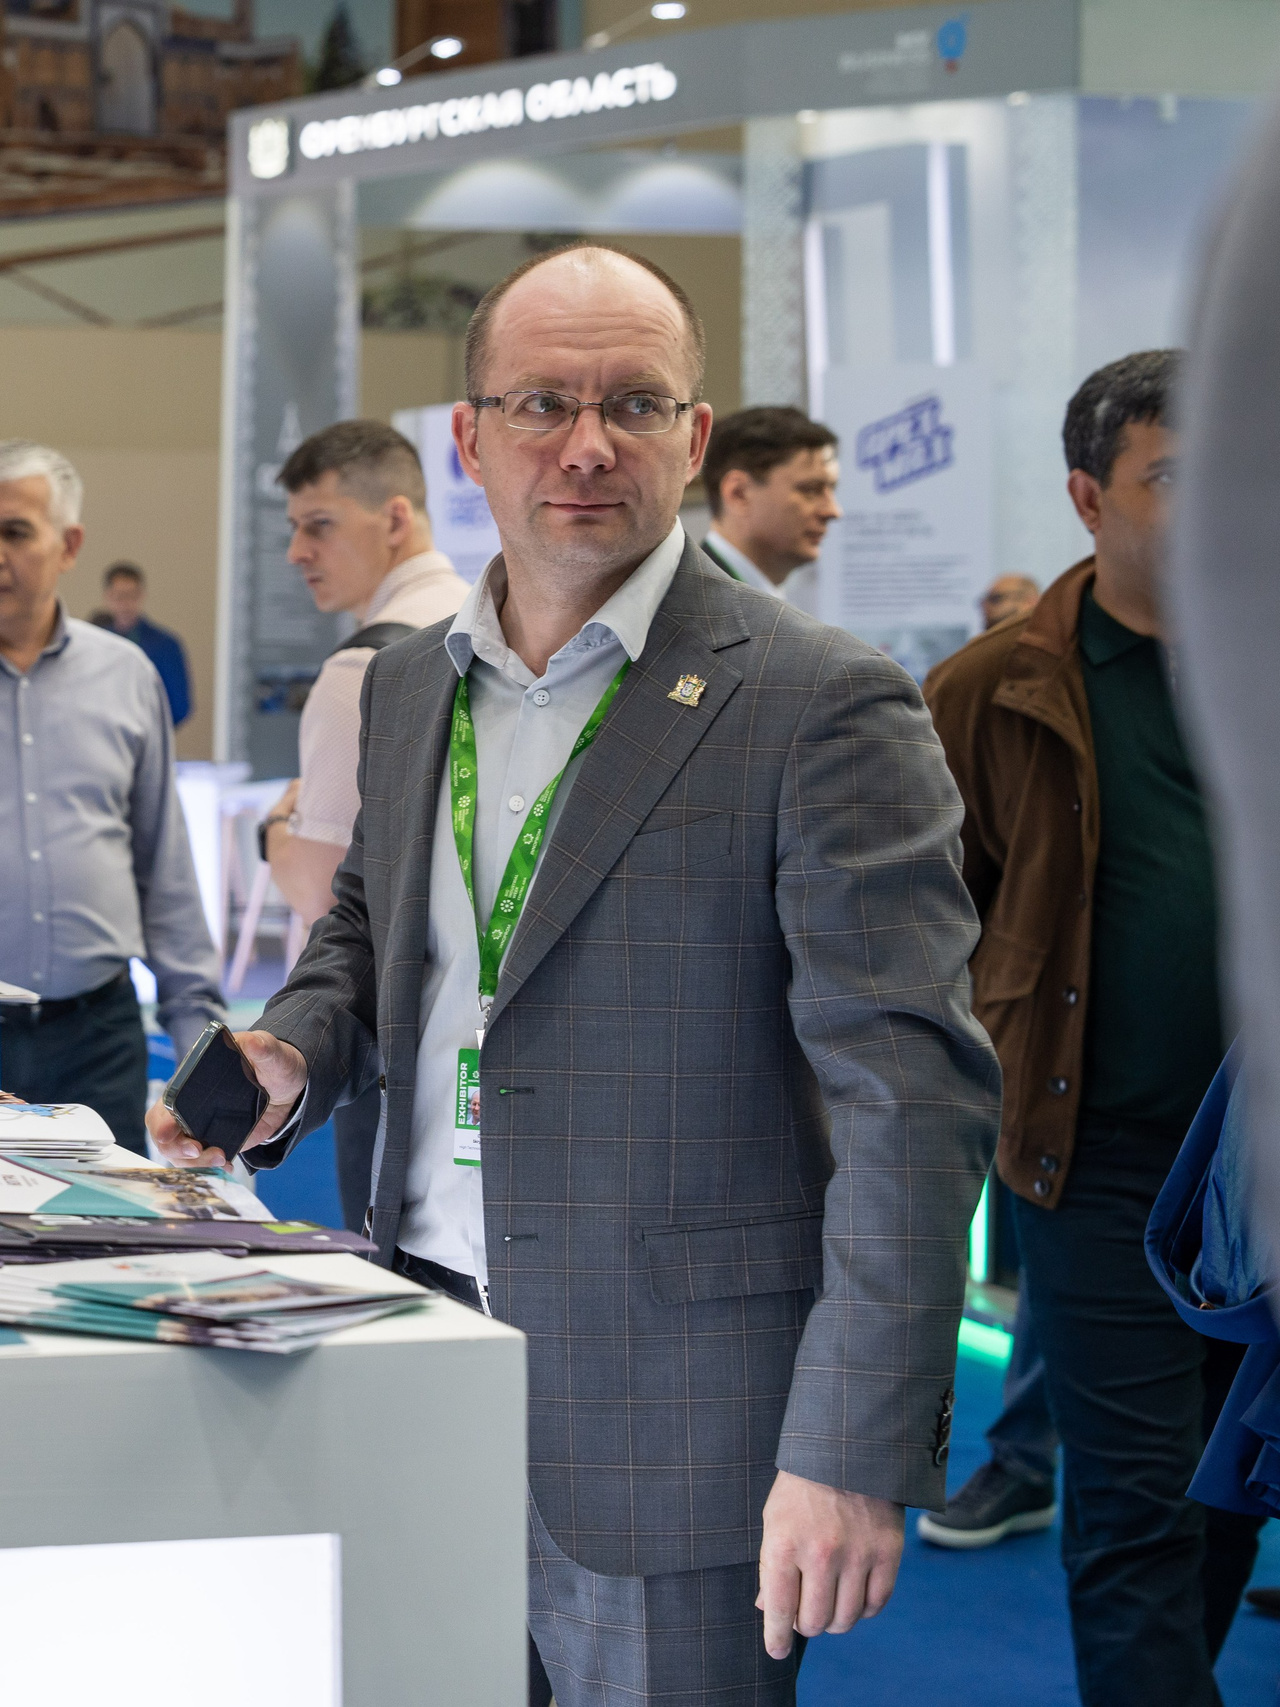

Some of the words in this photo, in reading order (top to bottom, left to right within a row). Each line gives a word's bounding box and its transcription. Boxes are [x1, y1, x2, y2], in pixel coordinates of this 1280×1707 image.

[299, 88, 524, 160] ОРЕНБУРГСКАЯ
[525, 61, 678, 123] ОБЛАСТЬ
[530, 828, 542, 856] INNOPROM
[499, 924, 511, 949] INNOPROM
[458, 1062, 468, 1125] EXHIBITOR
